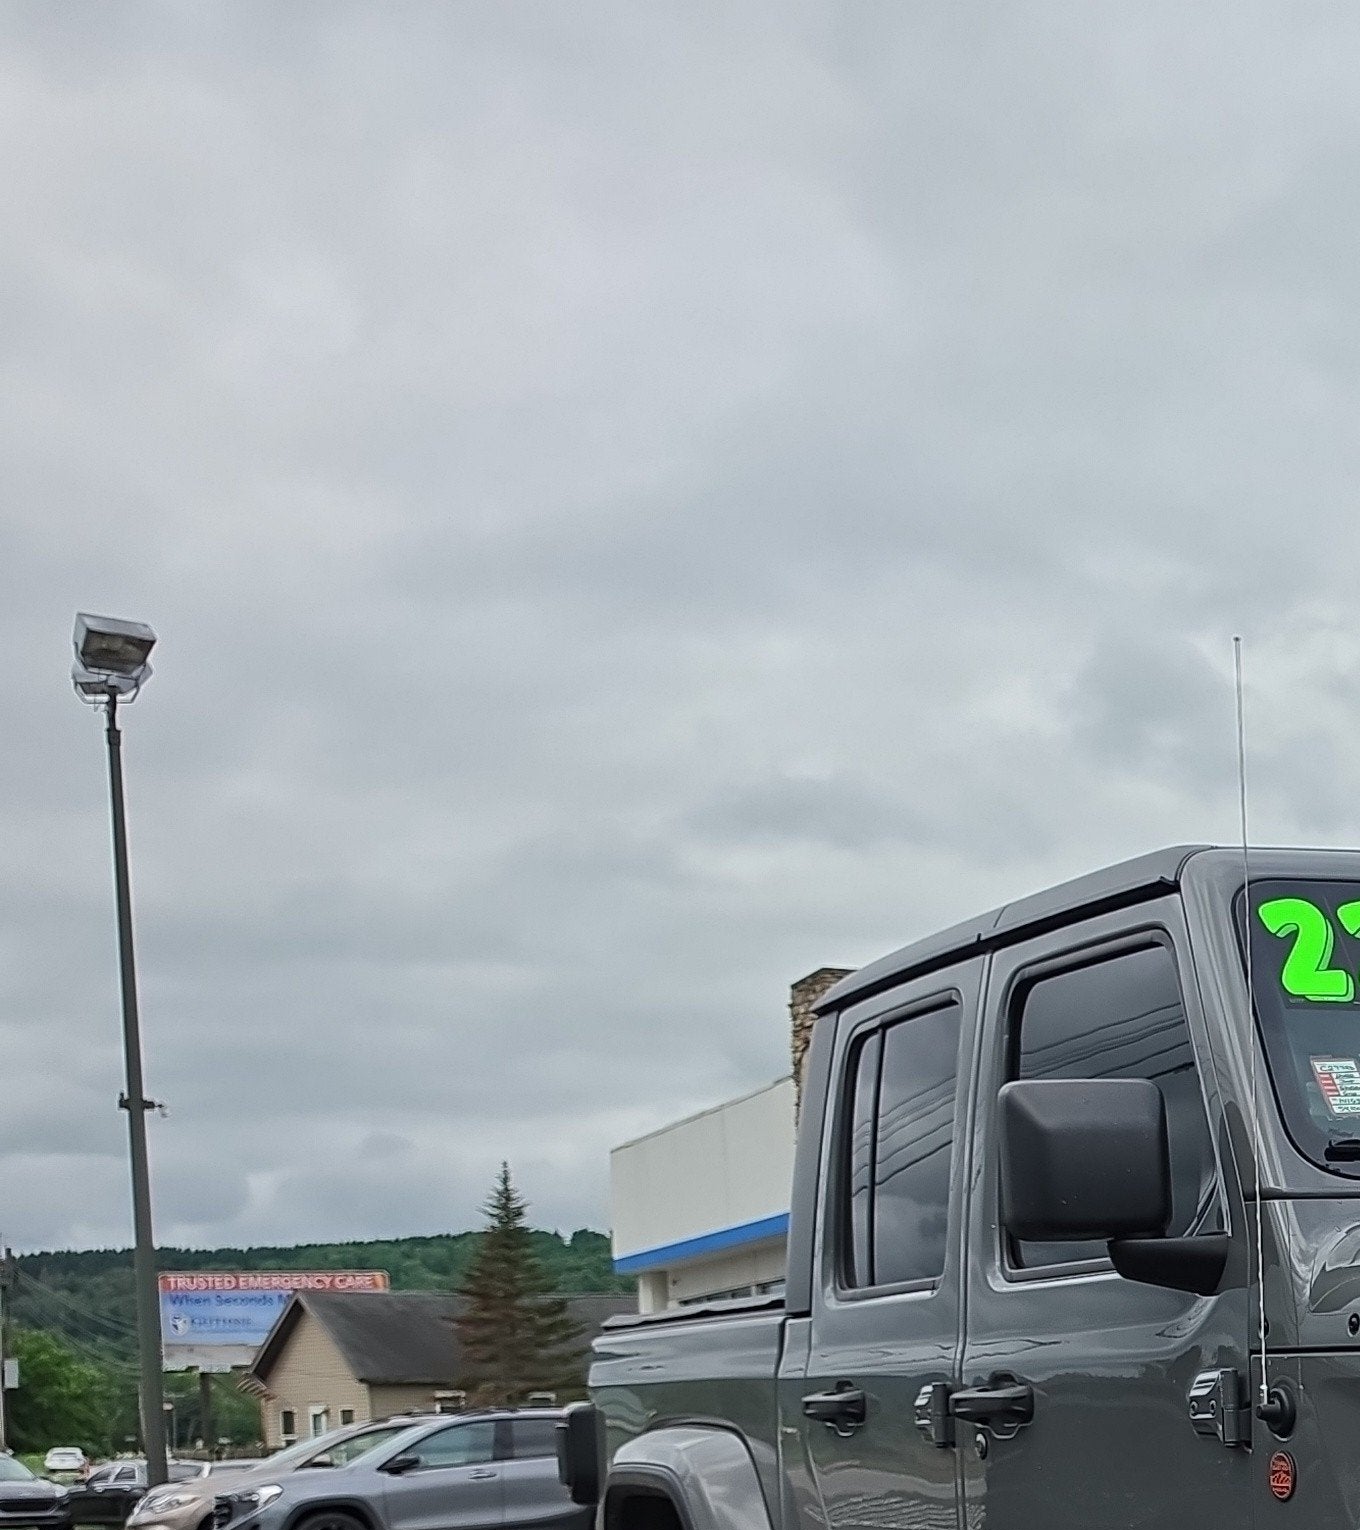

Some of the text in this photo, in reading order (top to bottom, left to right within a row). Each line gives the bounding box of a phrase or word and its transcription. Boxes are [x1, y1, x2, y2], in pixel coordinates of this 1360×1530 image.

[167, 1273, 374, 1291] TRUSTED EMERGENCY CARE
